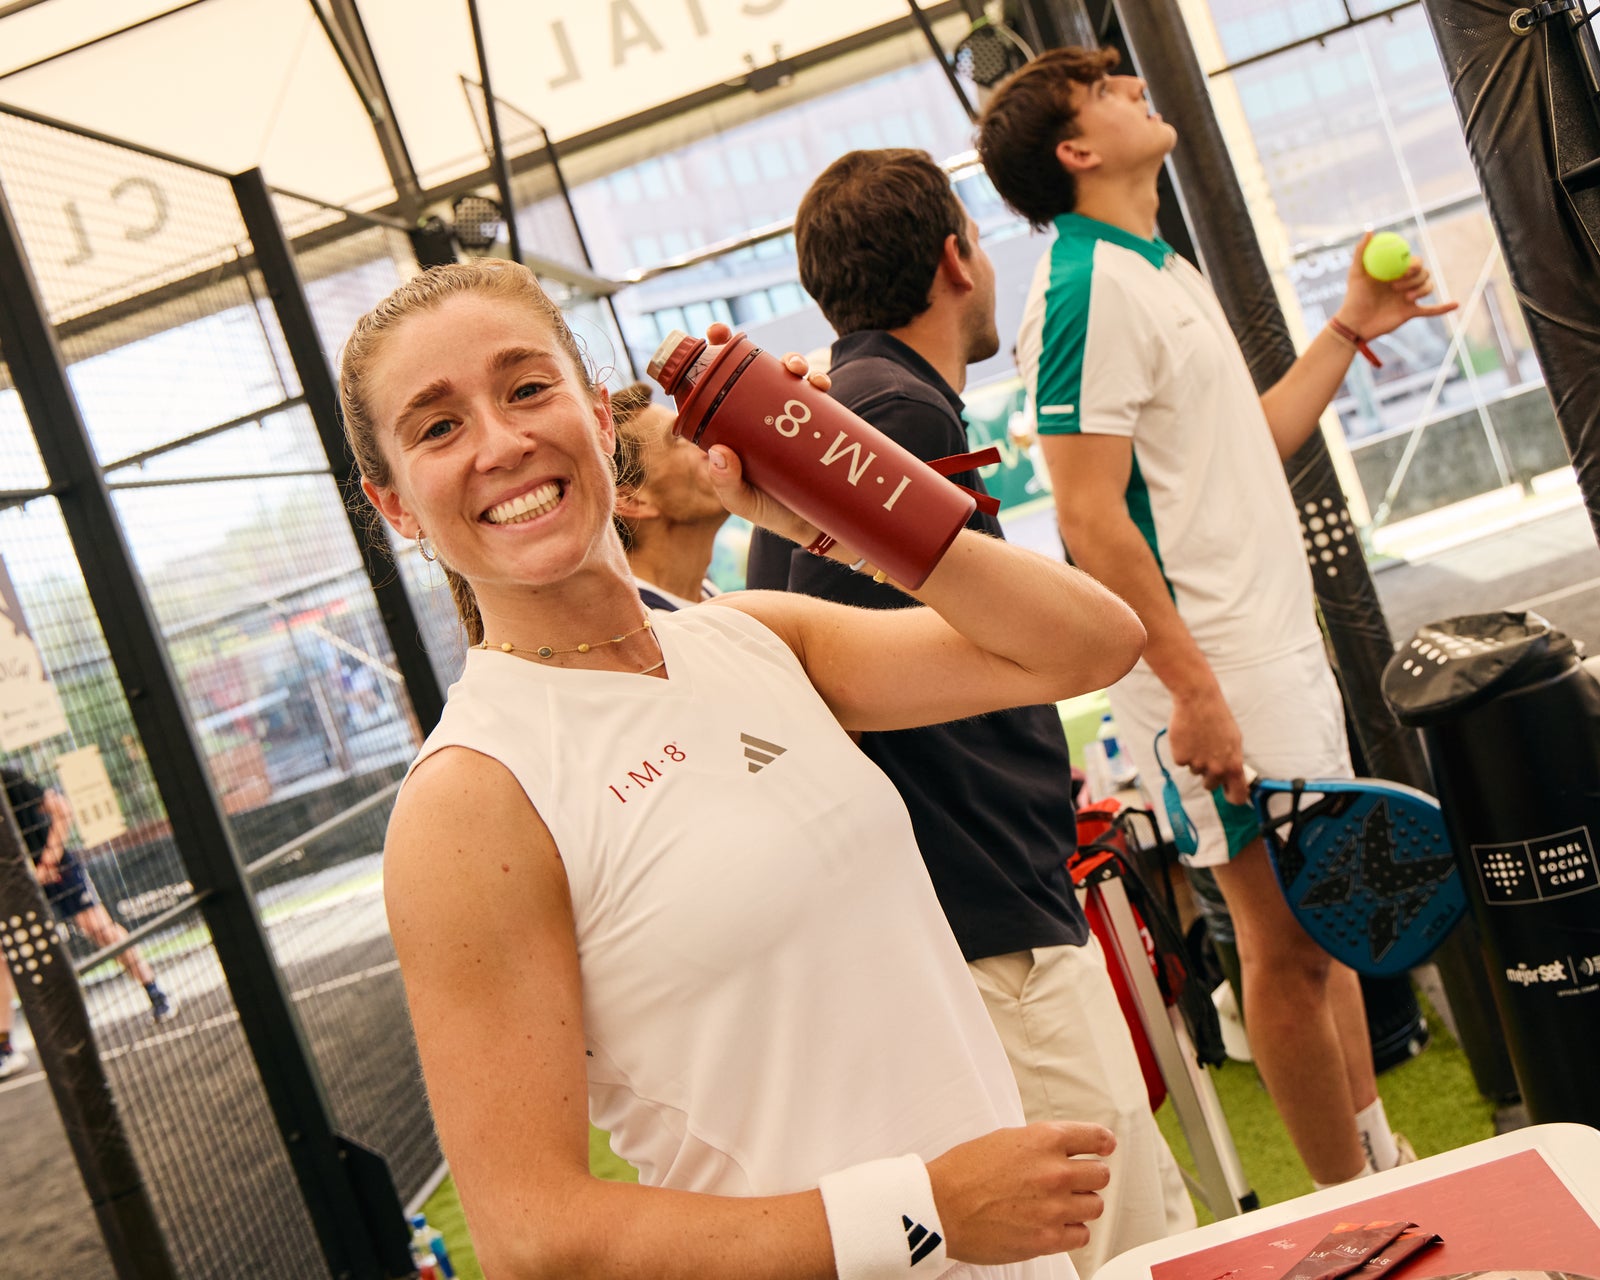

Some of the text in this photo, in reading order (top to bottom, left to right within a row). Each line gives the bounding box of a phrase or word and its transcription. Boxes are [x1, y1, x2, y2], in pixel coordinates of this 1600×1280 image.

[1538, 842, 1582, 860] PADEL
[1538, 853, 1589, 875] SOCIAL
[1550, 868, 1586, 886] CLUB
